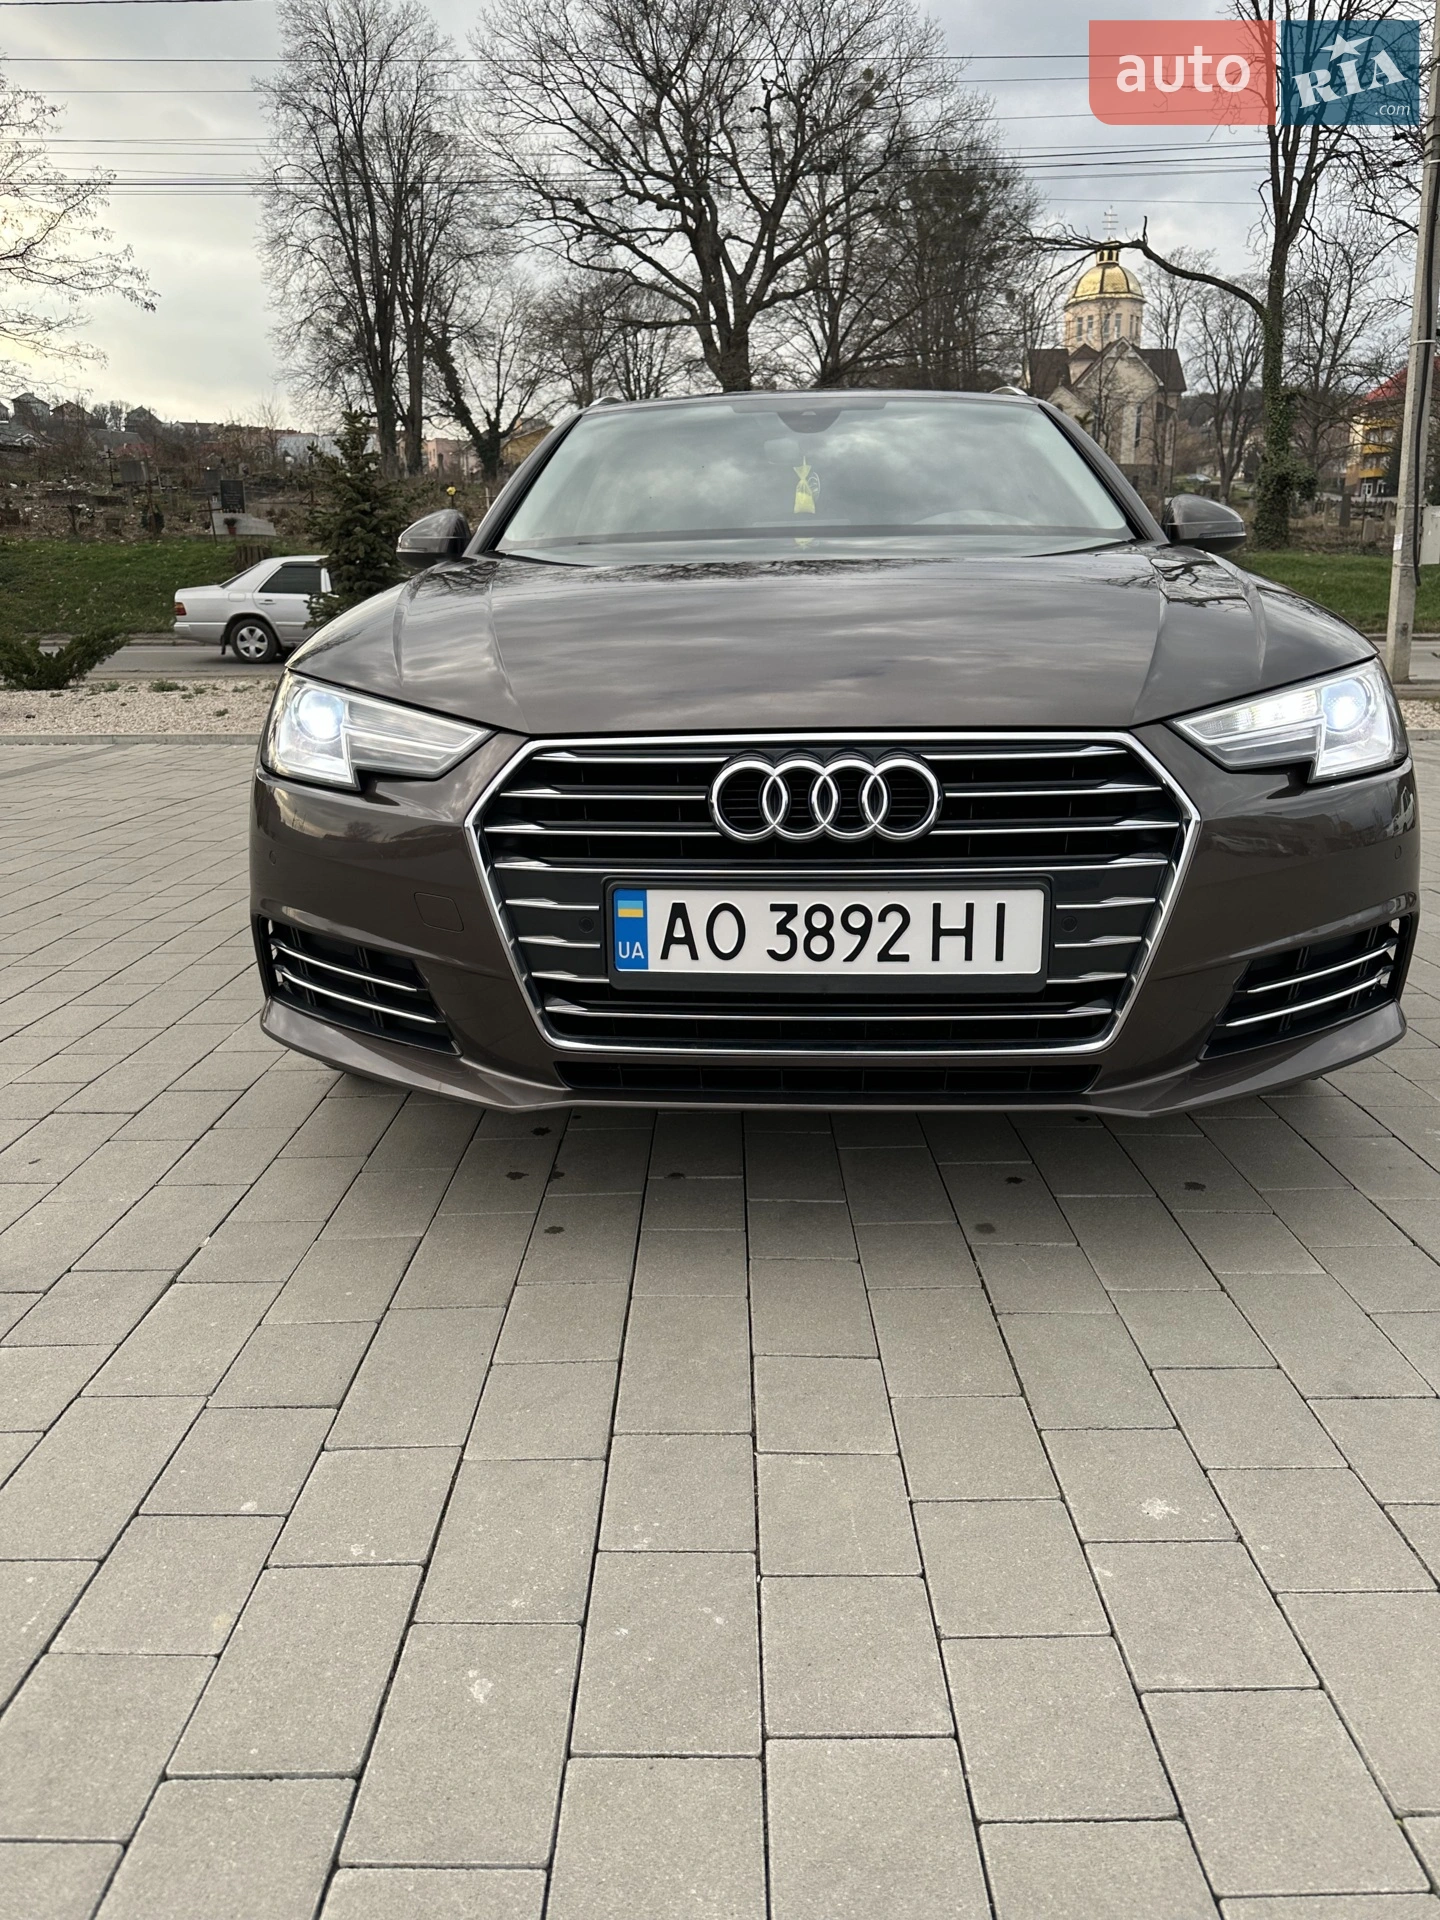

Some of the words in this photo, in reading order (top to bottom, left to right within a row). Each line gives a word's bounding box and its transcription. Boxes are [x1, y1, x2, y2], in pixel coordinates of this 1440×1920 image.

[618, 941, 645, 960] UA
[660, 902, 746, 961] AO
[766, 903, 911, 962] 3892
[931, 902, 1006, 962] HI
